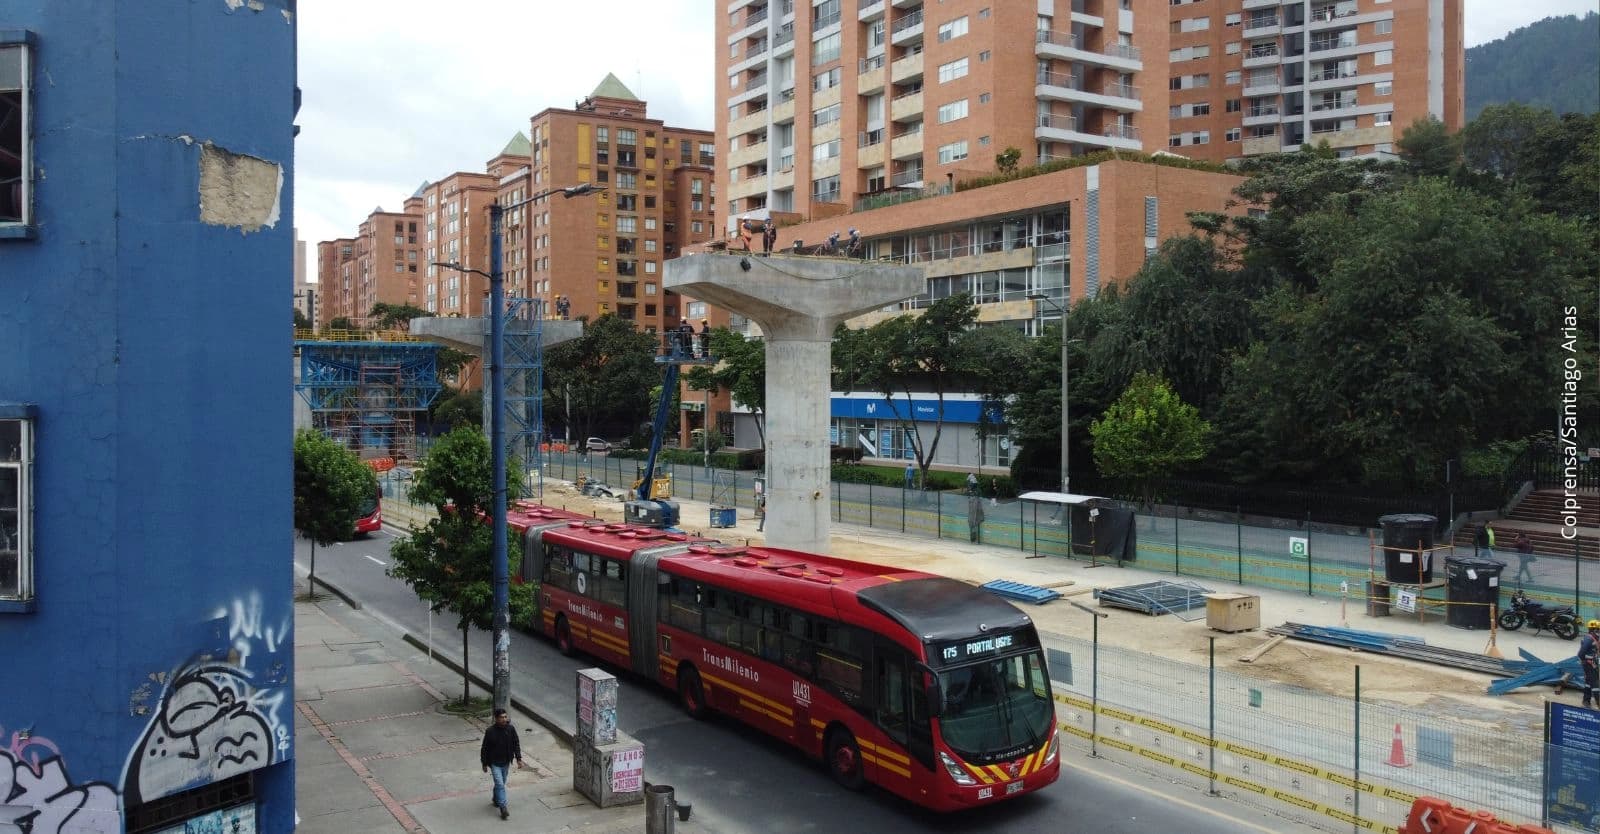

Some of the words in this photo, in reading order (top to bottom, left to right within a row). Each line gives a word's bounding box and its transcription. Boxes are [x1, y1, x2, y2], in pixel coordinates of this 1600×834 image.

[567, 599, 603, 623] TransMilenio
[943, 646, 958, 659] 175
[966, 638, 995, 655] PORTAL
[702, 647, 759, 682] TransMilenio
[613, 751, 643, 762] PLANOS
